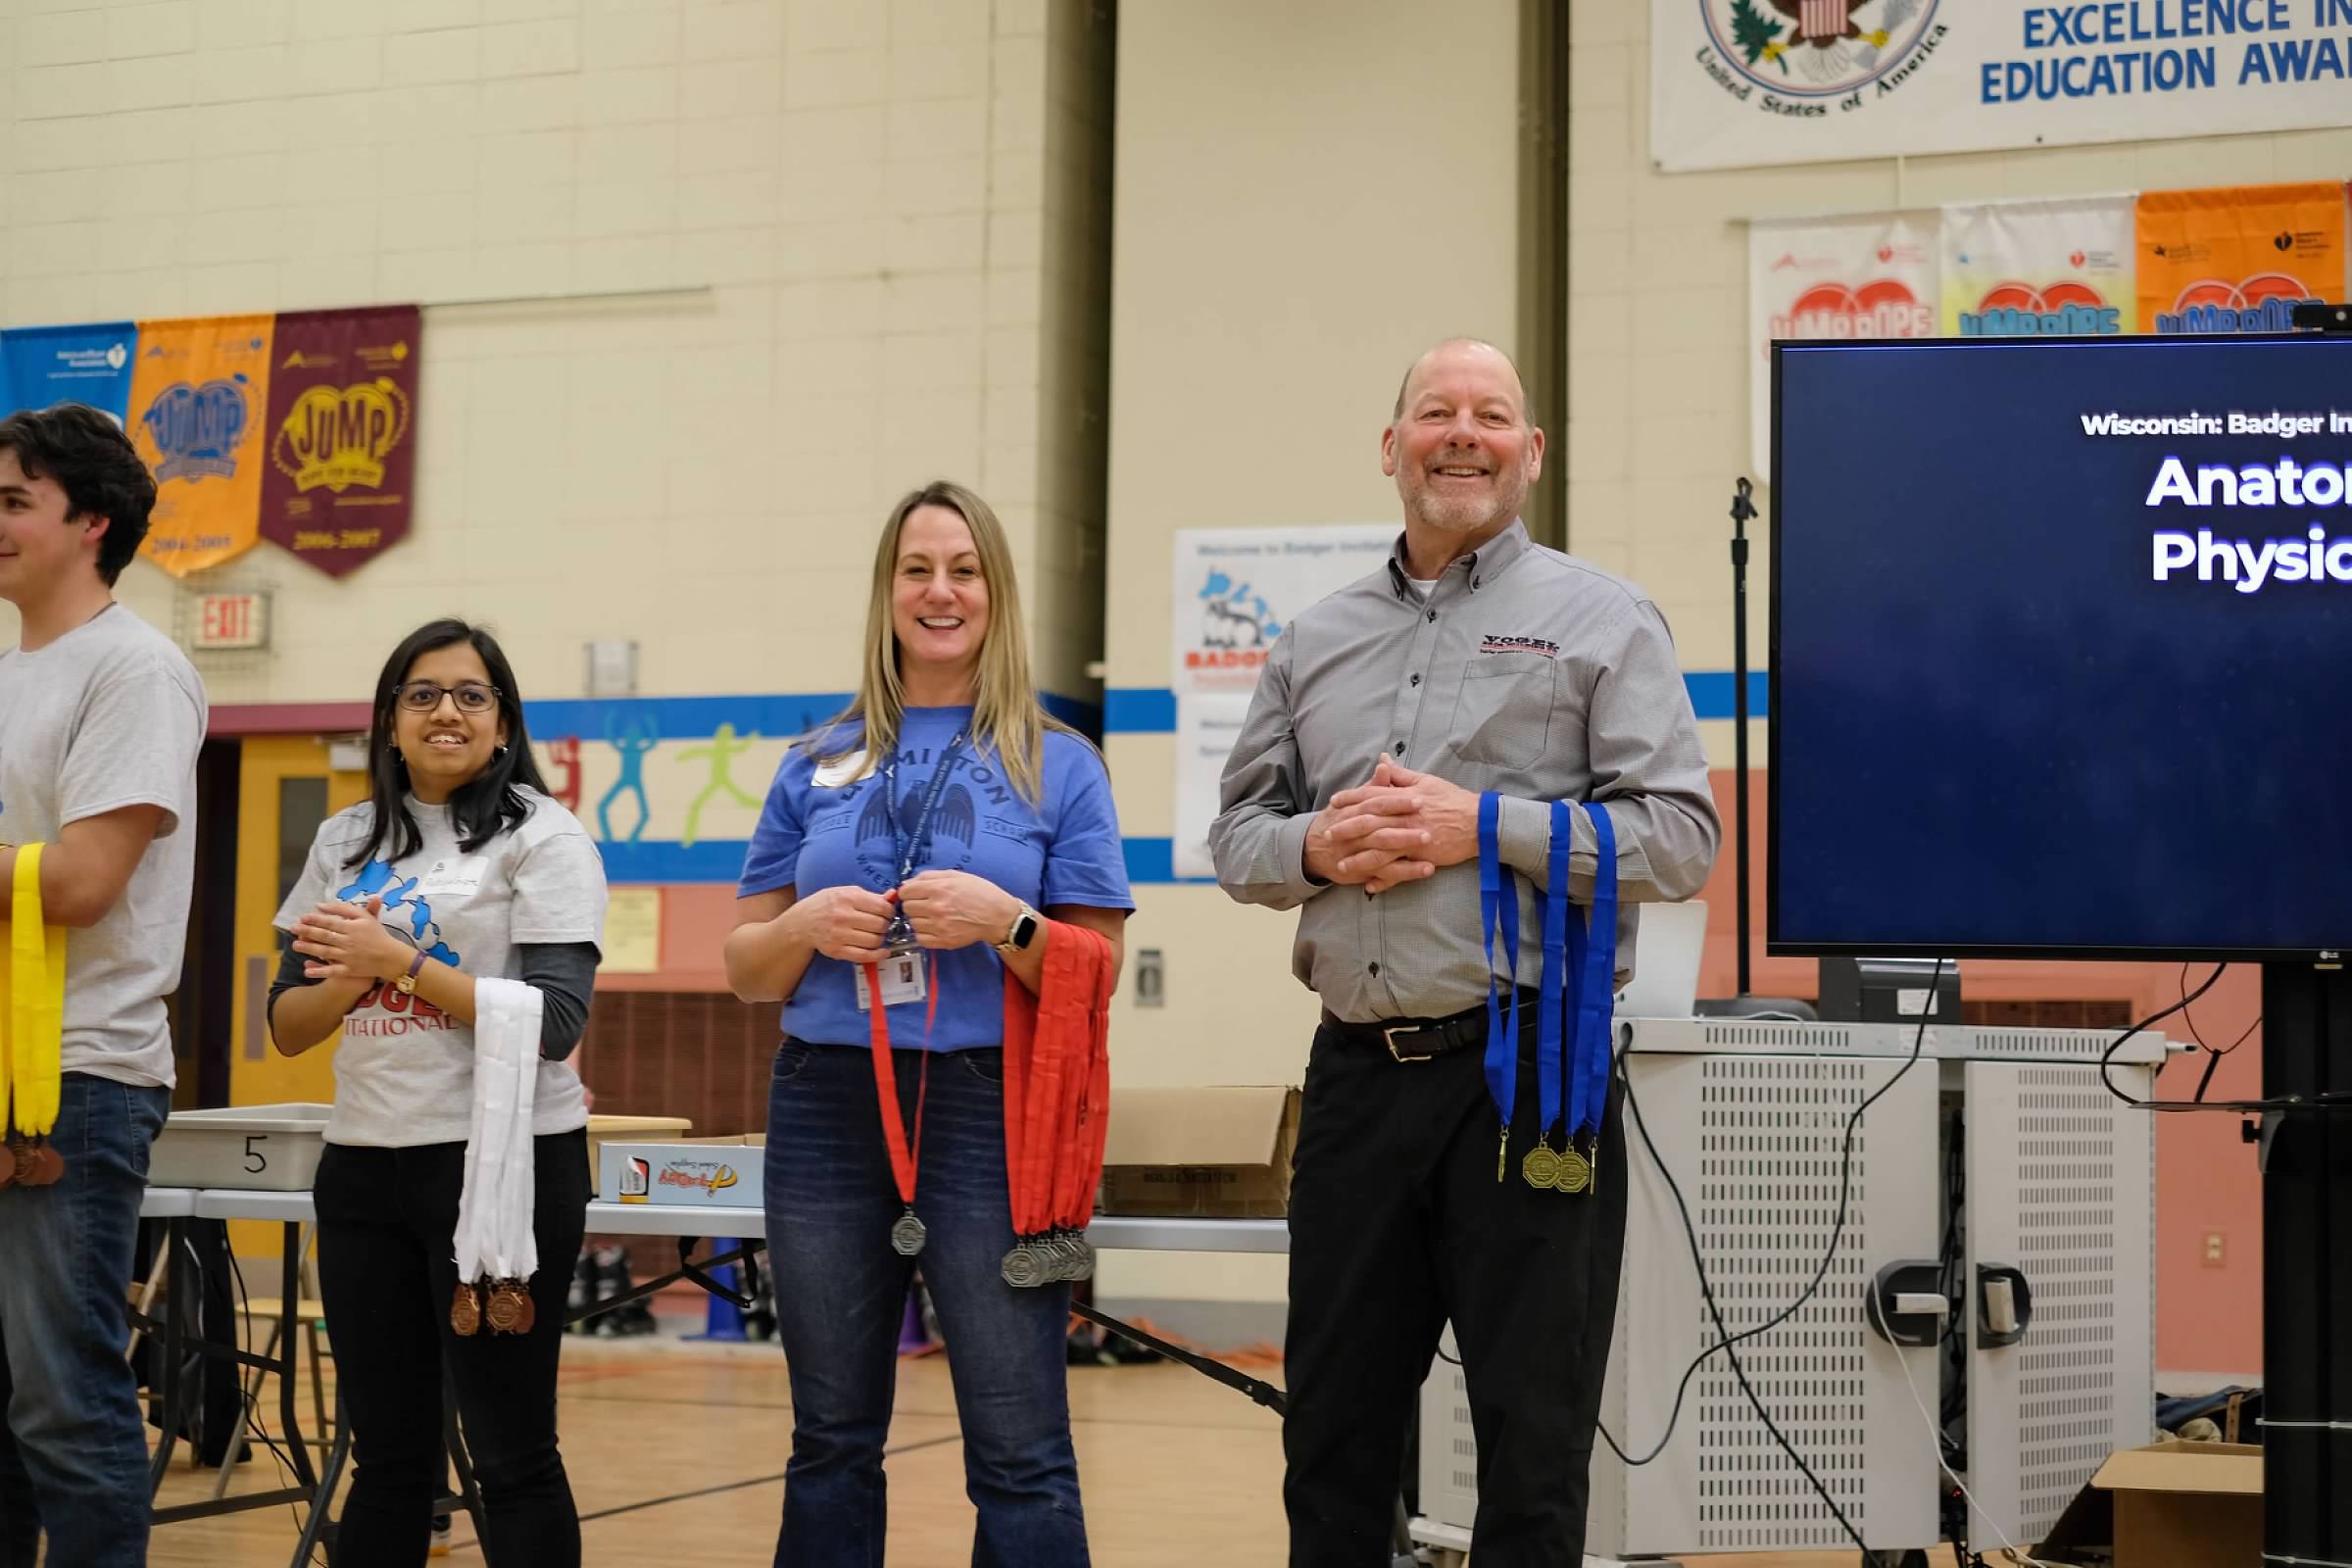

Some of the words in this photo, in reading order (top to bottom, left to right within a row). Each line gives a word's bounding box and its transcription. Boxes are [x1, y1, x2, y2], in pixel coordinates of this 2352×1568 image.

[2024, 0, 2289, 48] EXCELLENCE
[1695, 46, 1752, 101] United
[1760, 93, 1827, 118] States
[1840, 92, 1864, 113] of
[1877, 22, 1949, 98] America
[1981, 47, 2215, 104] EDUCATION
[2238, 37, 2352, 85] AWA
[155, 391, 242, 457] JUMP
[297, 397, 387, 462] JUMP
[2081, 412, 2223, 435] Wisconsin:
[2228, 412, 2325, 438] Badger
[2329, 413, 2352, 433] In
[204, 595, 251, 643] EXIT
[245, 1136, 268, 1173] 5
